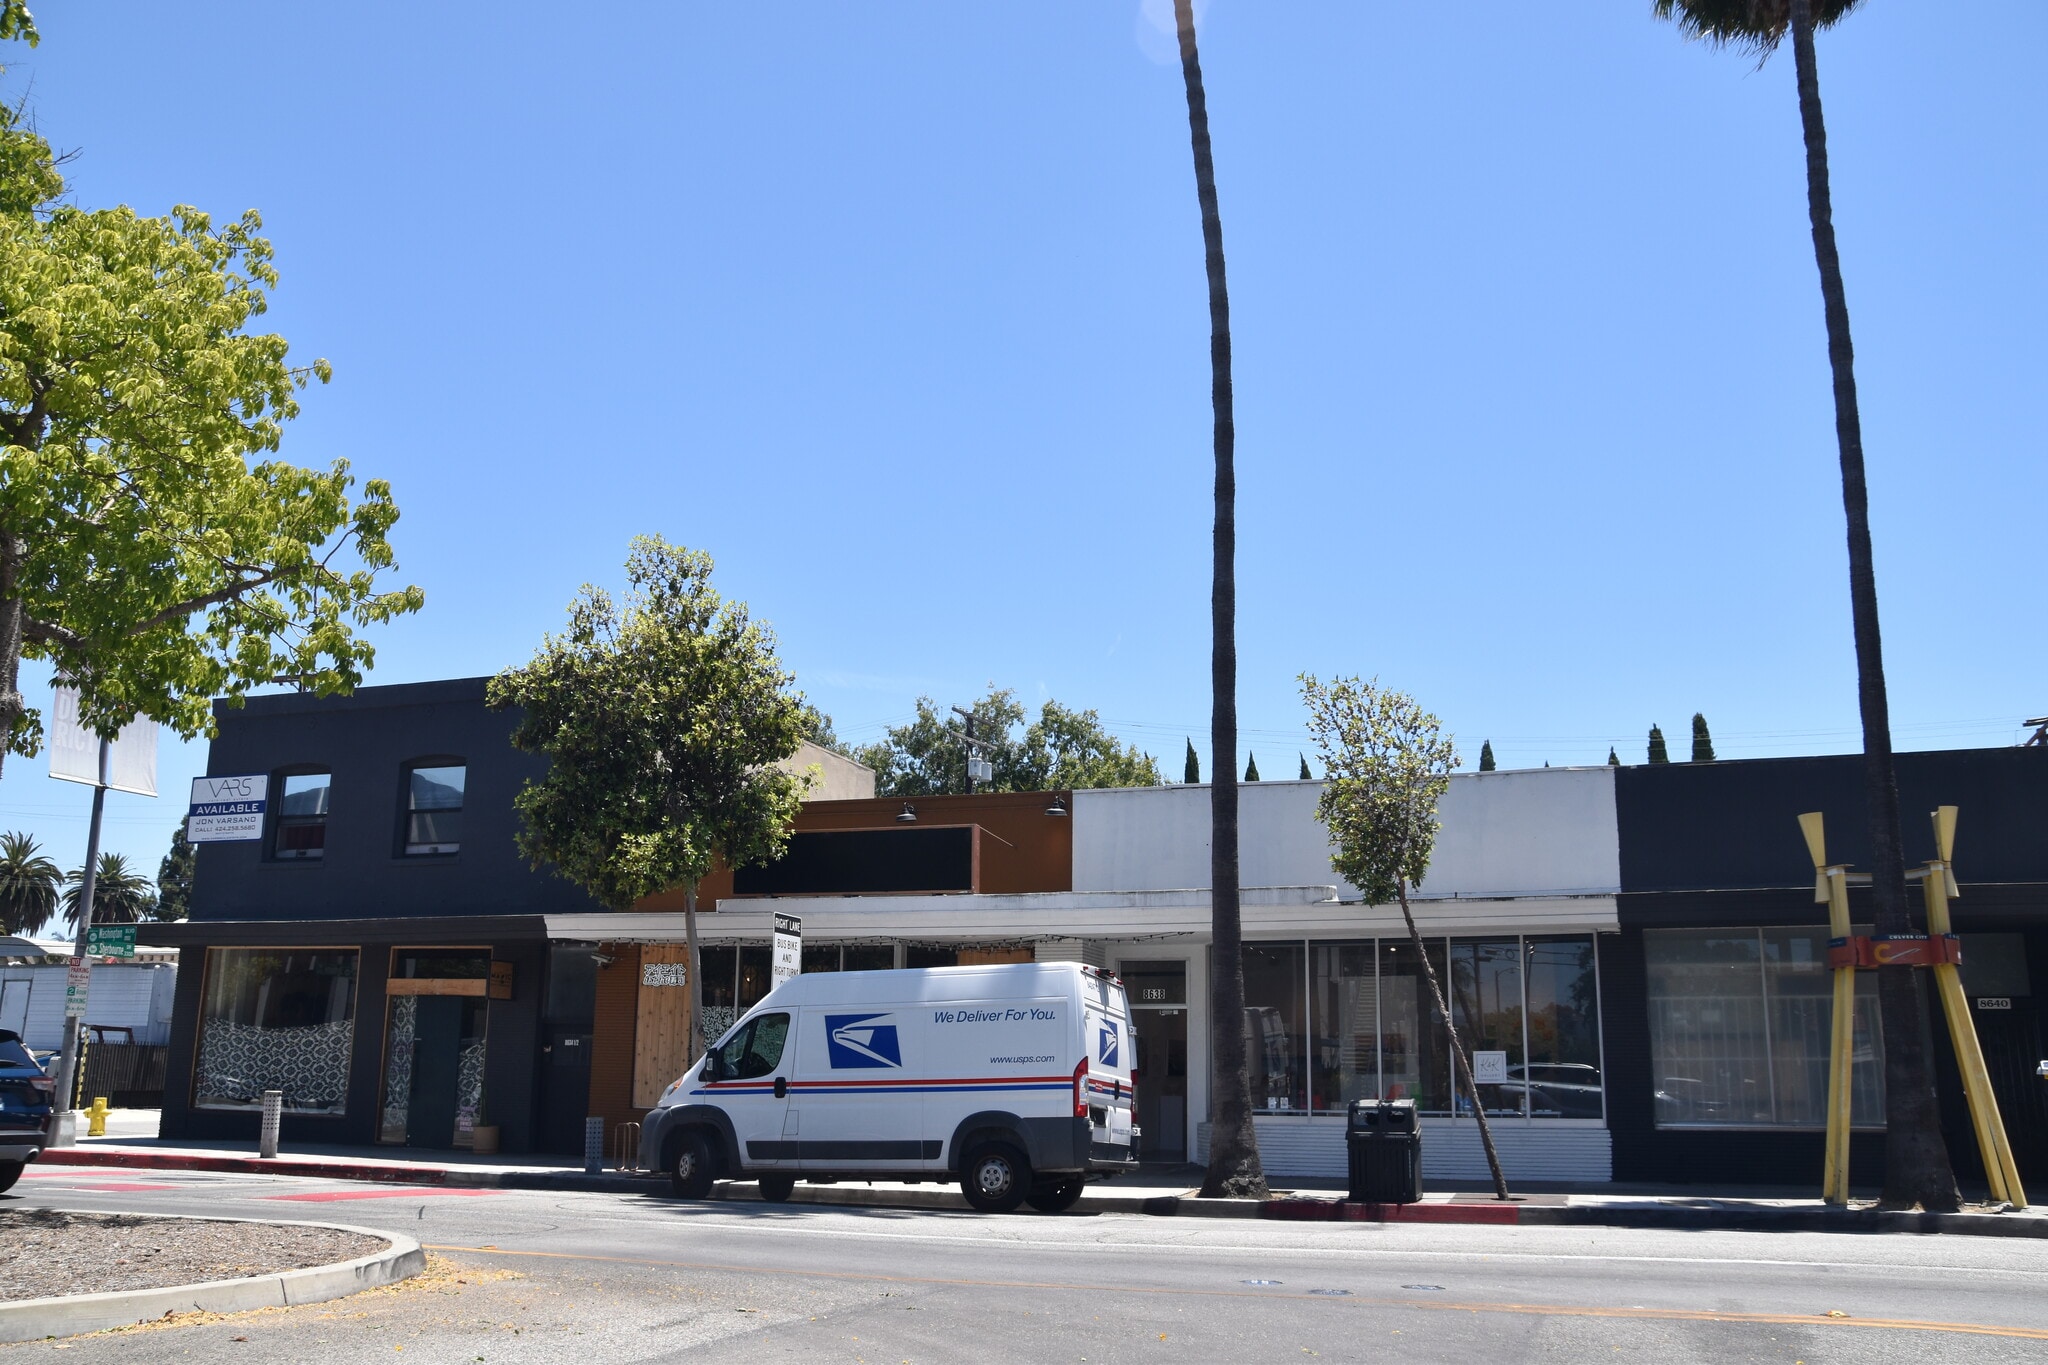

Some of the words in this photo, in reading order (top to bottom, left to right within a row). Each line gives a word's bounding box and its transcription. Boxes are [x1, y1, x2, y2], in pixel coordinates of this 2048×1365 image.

[208, 778, 252, 798] VARS
[196, 803, 259, 815] AVAILABLE
[775, 917, 788, 930] RIGHT
[789, 920, 801, 933] LANE
[98, 928, 123, 941] Washington
[99, 942, 124, 956] Sherbourne
[777, 938, 787, 949] BUS
[787, 940, 798, 951] BIKE
[782, 953, 792, 963] AND
[774, 965, 786, 976] RIGHT
[68, 987, 75, 995] 2
[1143, 989, 1165, 999] 8638
[1979, 999, 2009, 1008] 8640
[934, 1011, 954, 1024] We
[956, 1009, 1003, 1023] Deliver
[1005, 1008, 1028, 1021] For
[1029, 1008, 1056, 1020] You.
[990, 1054, 1055, 1065] www.usps.com
